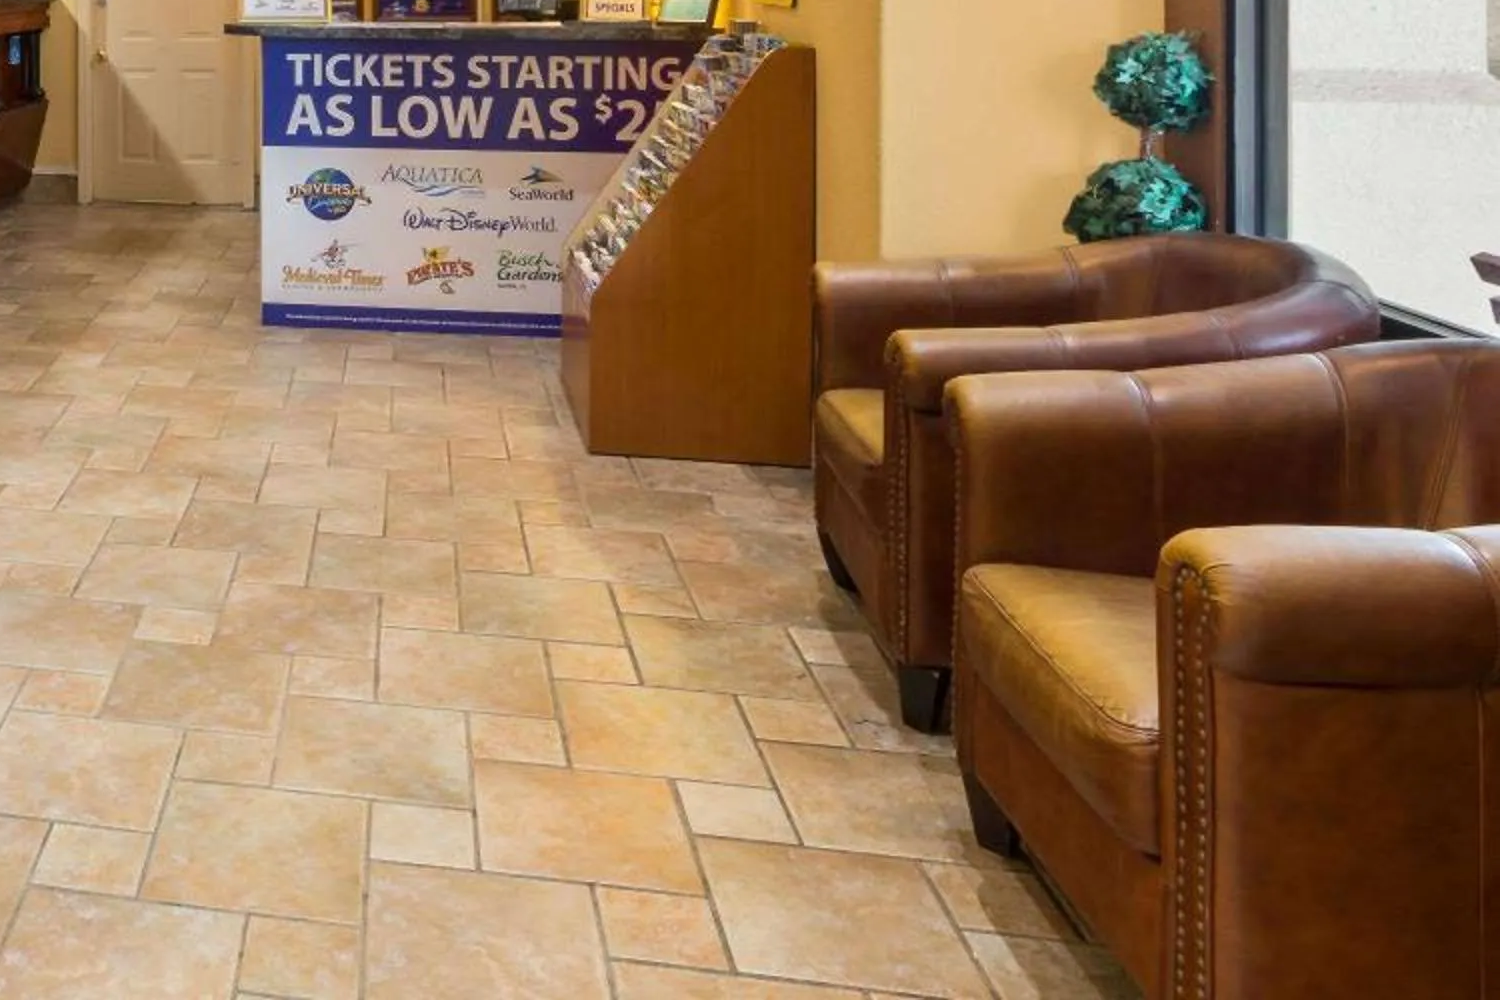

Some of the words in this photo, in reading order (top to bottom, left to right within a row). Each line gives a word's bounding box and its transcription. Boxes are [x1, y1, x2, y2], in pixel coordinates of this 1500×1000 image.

[595, 3, 635, 13] SPECIALS
[286, 53, 455, 89] TICKETS
[467, 55, 682, 91] STARTING
[285, 93, 355, 137] AS
[371, 95, 493, 139] LOW
[507, 96, 580, 141] AS
[595, 93, 661, 142] $2
[381, 163, 484, 187] AQUATICA
[287, 182, 366, 199] UNIVERSAL
[508, 187, 575, 201] SeaWorld
[498, 250, 553, 268] Busch
[282, 264, 341, 285] Medieval
[343, 267, 384, 287] Times
[497, 266, 564, 283] Gardens
